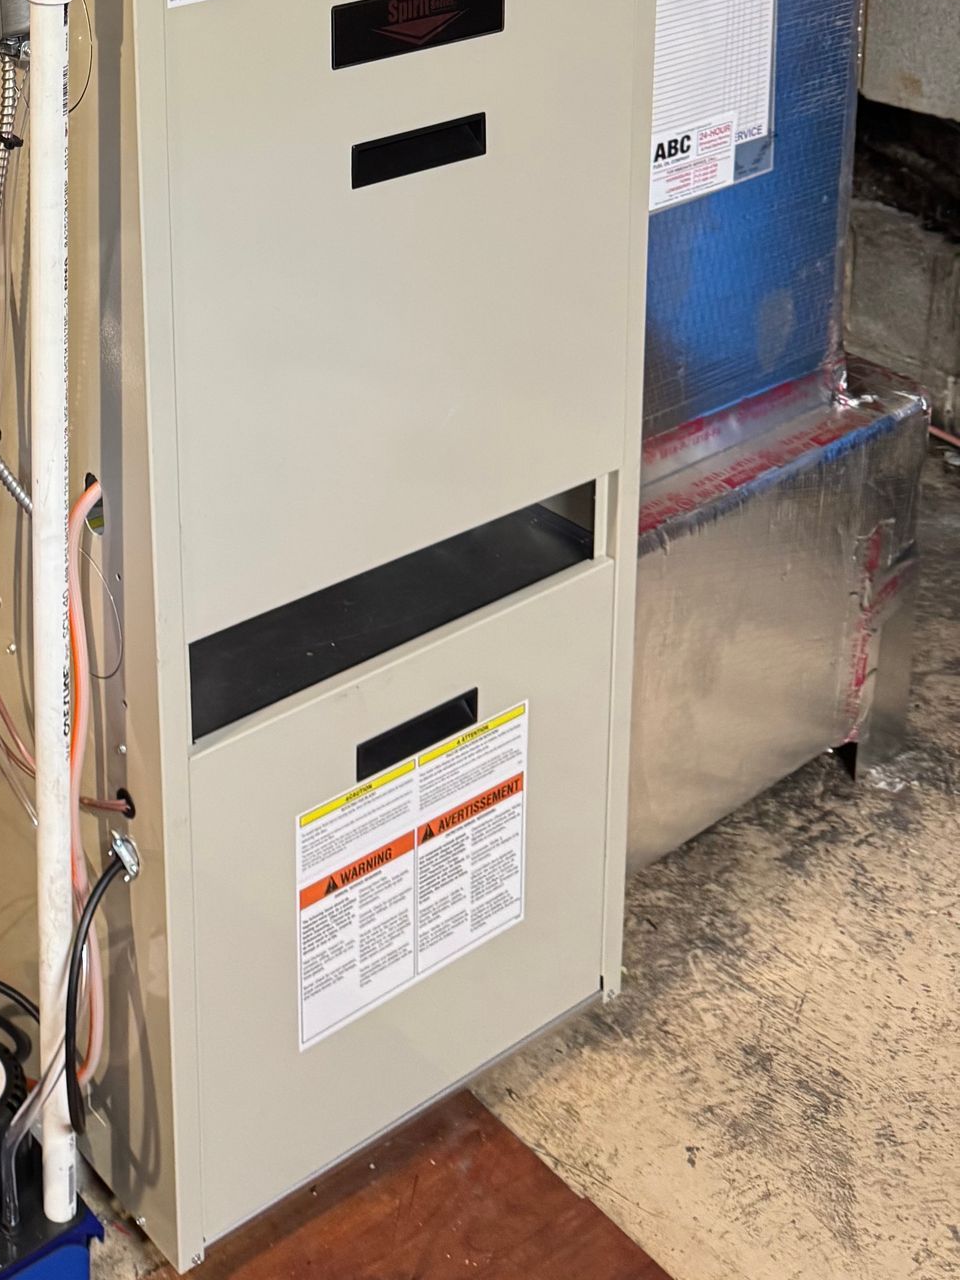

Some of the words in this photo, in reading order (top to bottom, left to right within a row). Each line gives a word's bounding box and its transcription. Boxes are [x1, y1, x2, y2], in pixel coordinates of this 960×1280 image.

[654, 134, 691, 163] ABC
[735, 124, 762, 142] ERVICE
[438, 778, 519, 833] AVERTISSEMENT
[340, 848, 393, 885] WARNING
